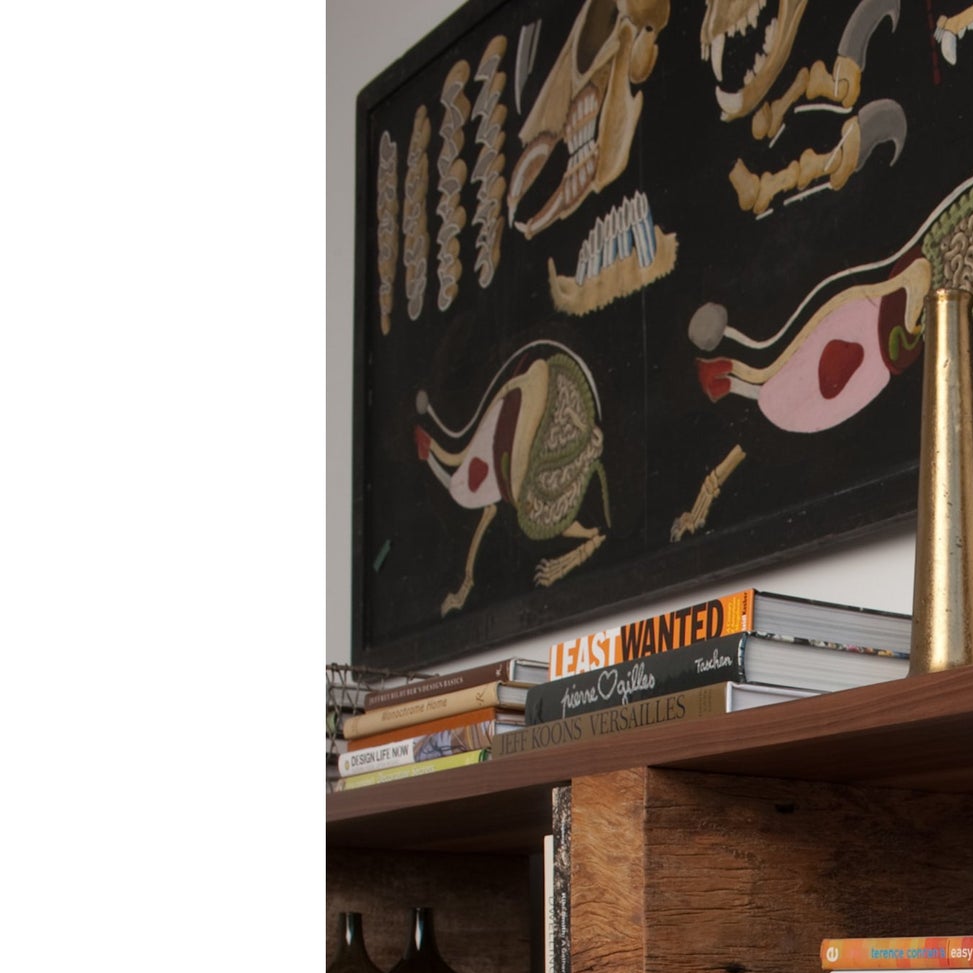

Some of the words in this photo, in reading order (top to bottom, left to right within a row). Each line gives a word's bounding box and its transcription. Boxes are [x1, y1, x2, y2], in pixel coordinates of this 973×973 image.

[551, 627, 621, 680] LEAST
[620, 599, 724, 662] WANTED
[694, 648, 734, 675] Taschen
[561, 681, 599, 720] pierre
[616, 662, 656, 706] gilles
[500, 725, 528, 755] JEFF
[531, 715, 583, 748] KOONS
[589, 694, 687, 736] VERSAILLES
[351, 752, 376, 767] DESIGN
[376, 749, 391, 762] LIFE
[391, 744, 409, 758] NOW
[871, 947, 904, 959] terence
[950, 946, 973, 961] easy
